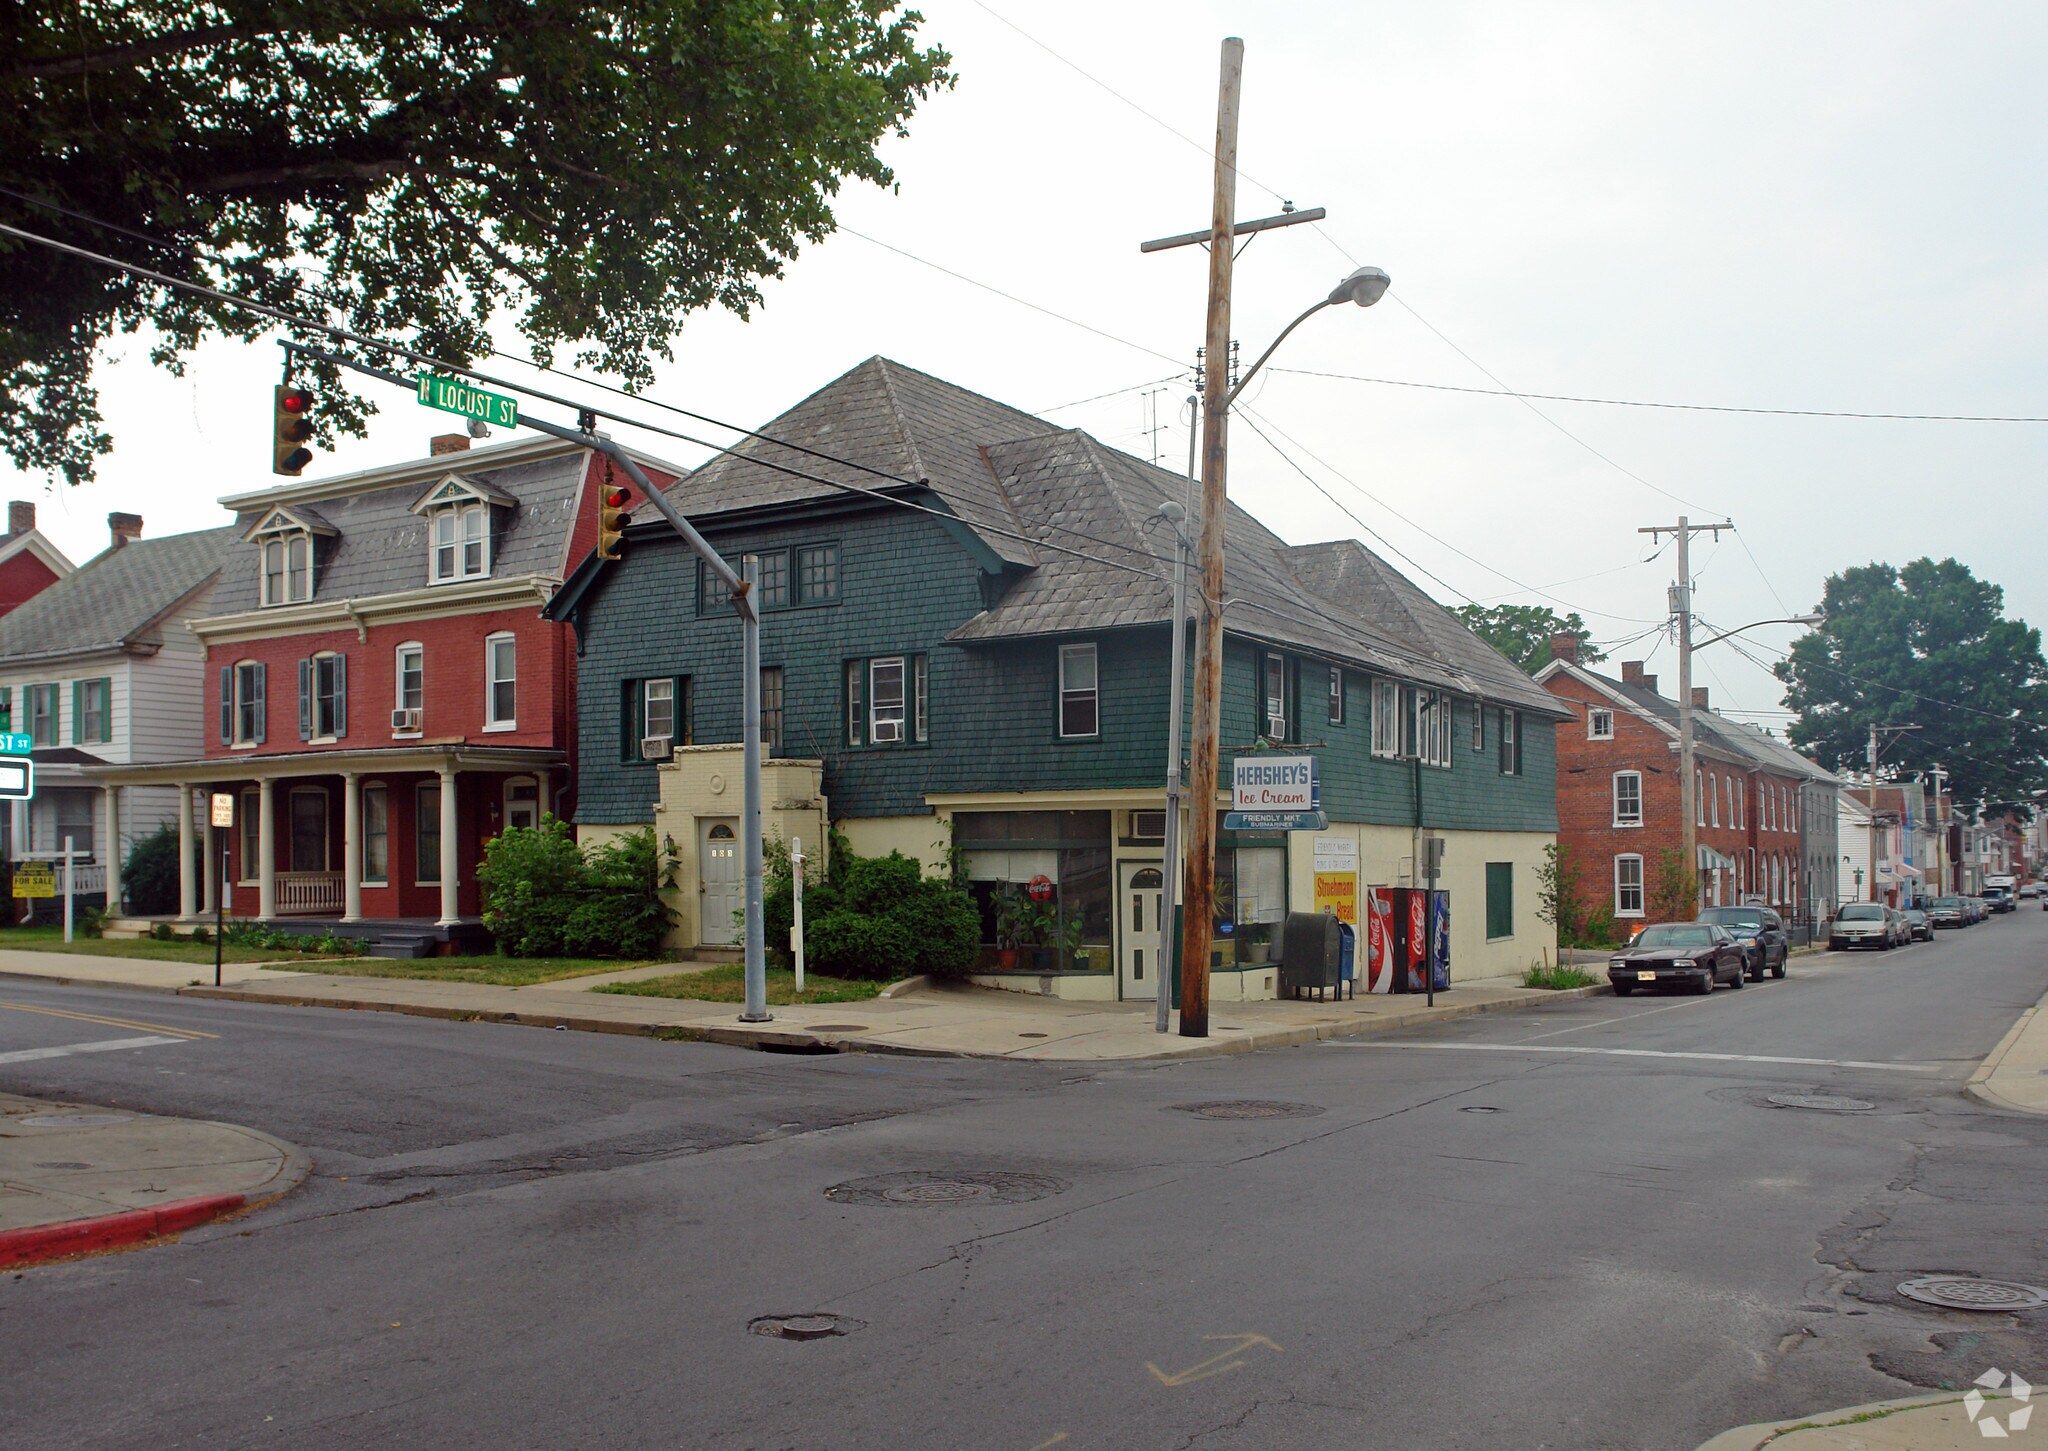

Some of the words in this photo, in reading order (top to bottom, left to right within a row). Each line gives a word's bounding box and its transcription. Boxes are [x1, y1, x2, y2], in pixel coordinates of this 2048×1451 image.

[420, 378, 430, 402] N
[439, 382, 493, 418] LOCUST
[500, 400, 516, 424] ST
[17, 739, 28, 748] ST
[1237, 762, 1308, 785] HERSHEY'S
[1239, 789, 1257, 804] Ice
[1261, 789, 1305, 804] Cream
[1242, 814, 1280, 822] FRIENDLY
[1283, 814, 1302, 822] MKT.
[1317, 877, 1354, 897] Stroehmann
[1337, 900, 1354, 920] Bread
[1434, 911, 1444, 959] PEPSI
